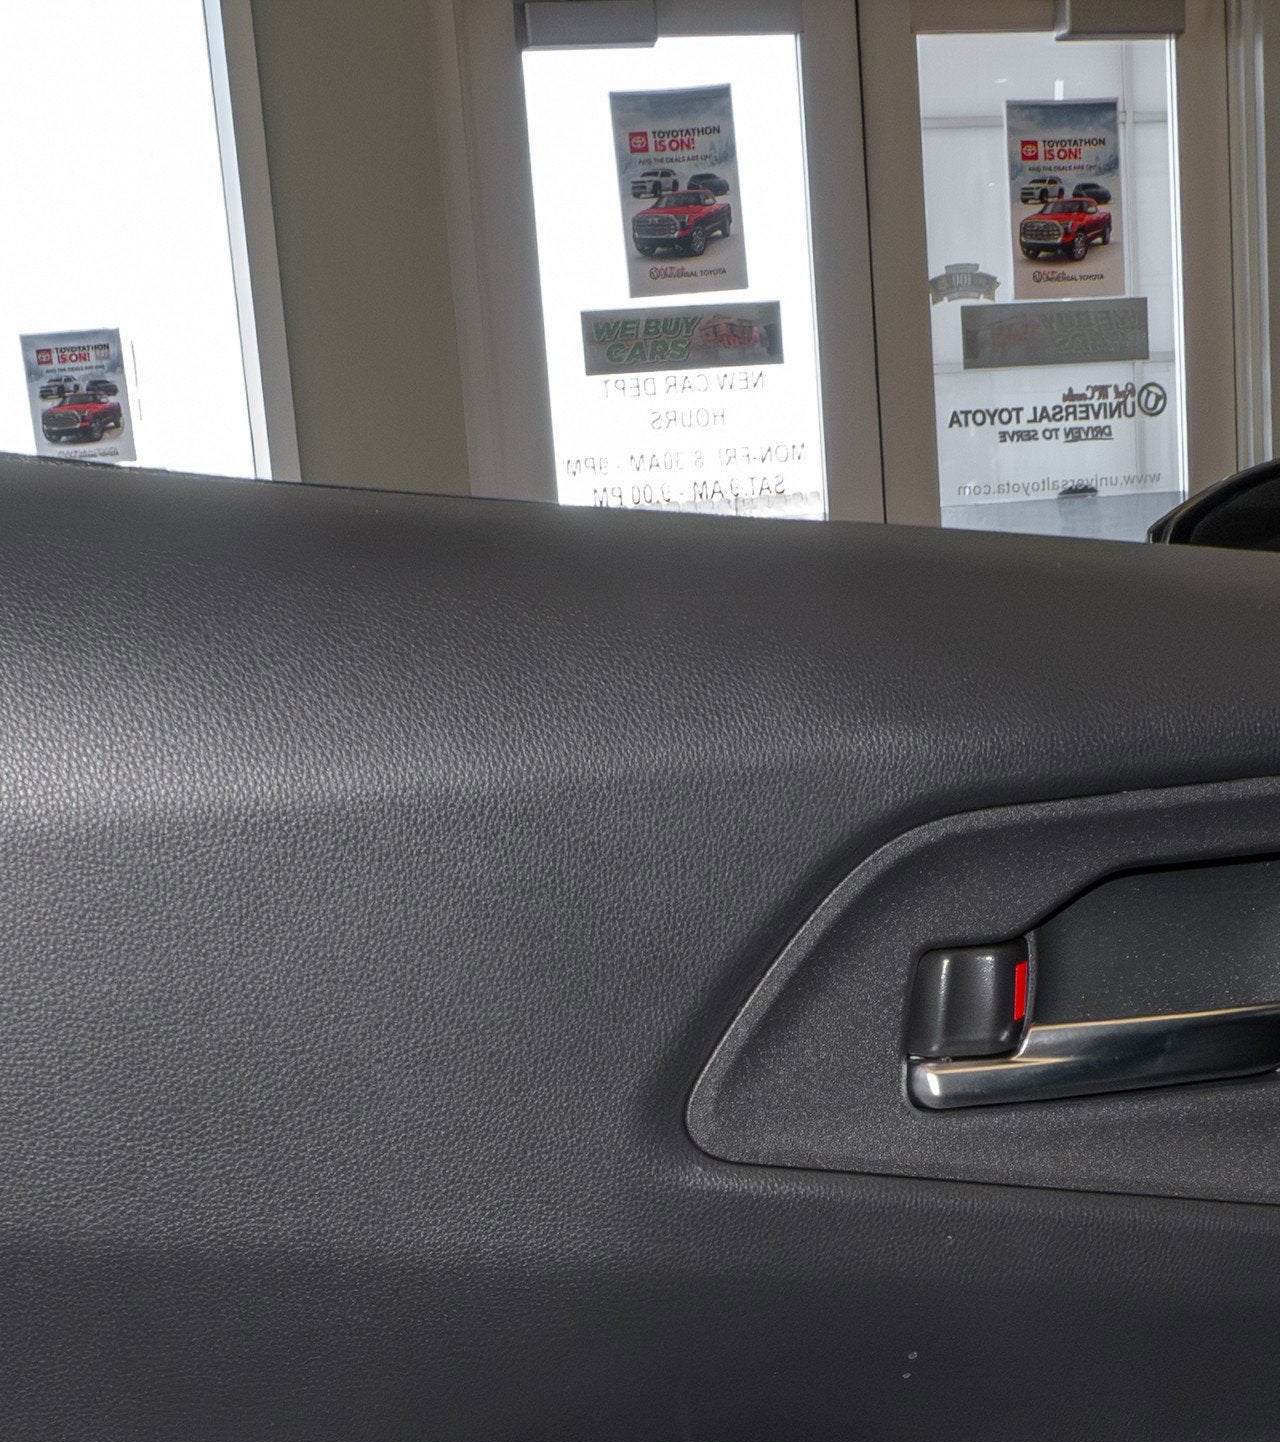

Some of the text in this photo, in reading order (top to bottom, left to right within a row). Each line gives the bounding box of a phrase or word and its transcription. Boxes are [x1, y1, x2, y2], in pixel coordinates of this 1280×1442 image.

[651, 125, 721, 139] TOYOTATHON
[654, 138, 696, 152] IS ON!
[1042, 137, 1106, 149] TOYOTATHON
[1044, 148, 1082, 161] IS ON!
[594, 315, 703, 342] WE BUY
[54, 343, 110, 354] TOYOTATHON
[606, 338, 691, 364] CARS
[57, 353, 67, 364] IS
